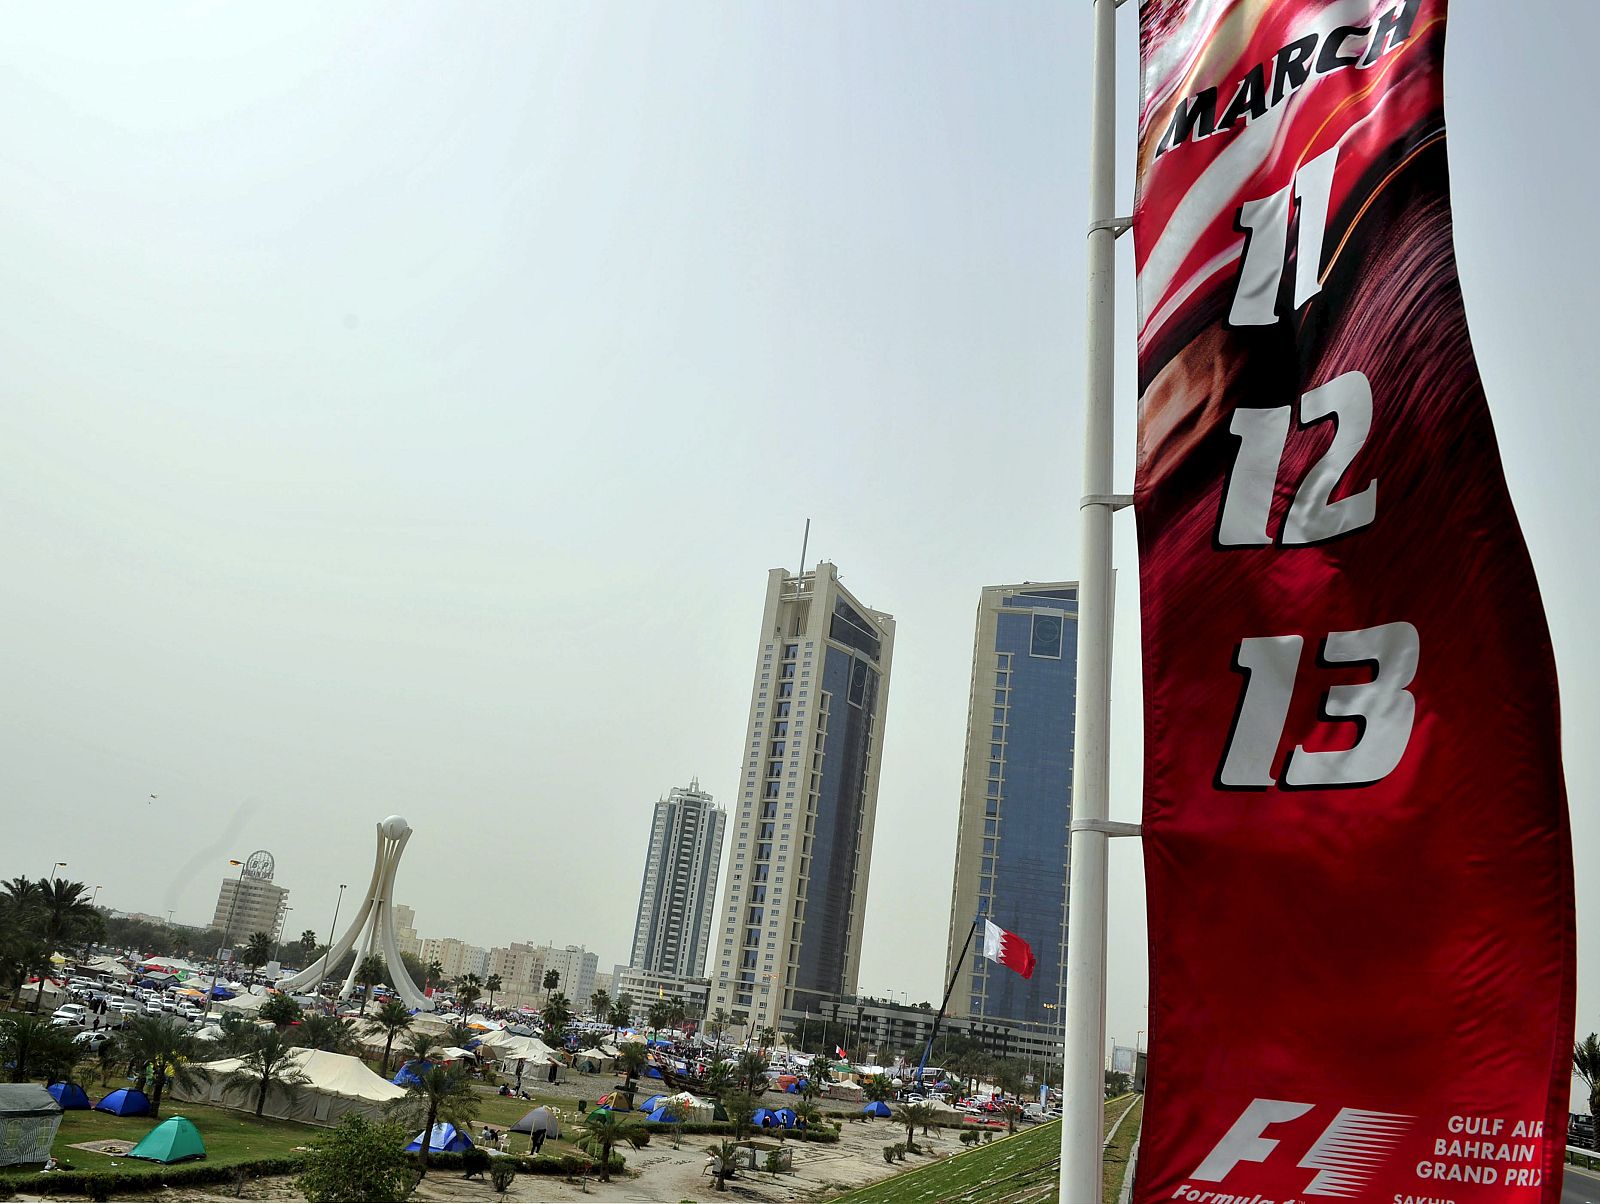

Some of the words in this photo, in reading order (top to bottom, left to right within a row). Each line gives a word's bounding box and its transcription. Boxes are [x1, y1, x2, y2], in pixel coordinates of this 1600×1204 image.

[1153, 0, 1422, 163] MARCH
[1228, 146, 1340, 326] 11
[1216, 370, 1378, 548] 12
[1217, 621, 1420, 789] 13
[1416, 1160, 1498, 1185] GRAND
[1434, 1138, 1535, 1162] BAHRAIN
[1447, 1115, 1504, 1136] GULF
[1511, 1120, 1543, 1138] AIR
